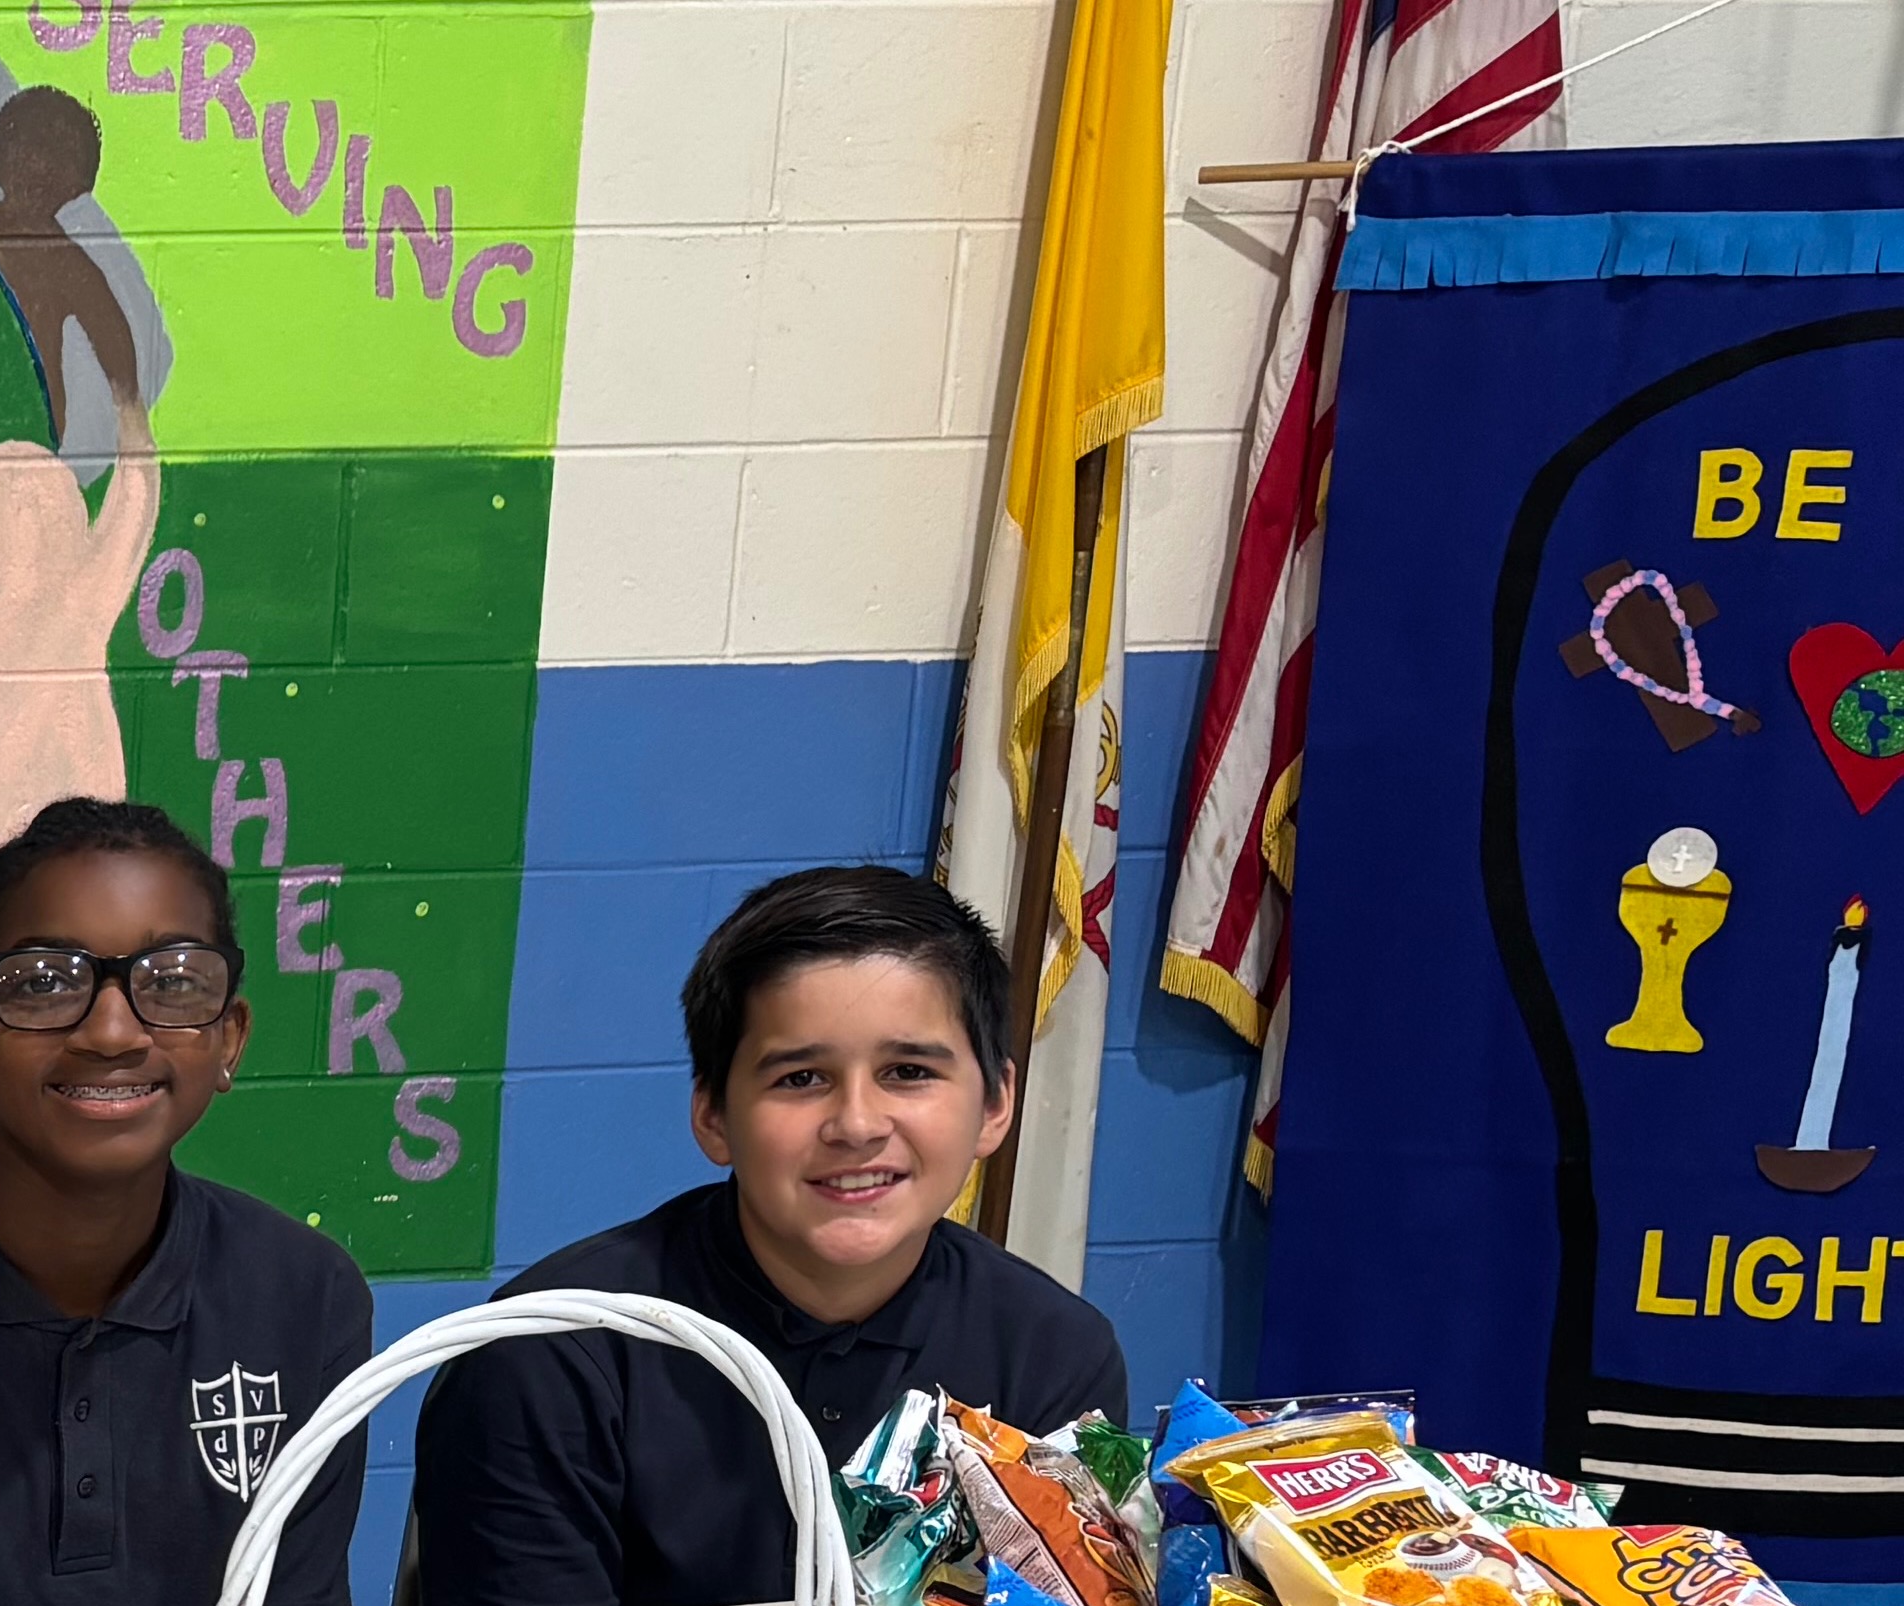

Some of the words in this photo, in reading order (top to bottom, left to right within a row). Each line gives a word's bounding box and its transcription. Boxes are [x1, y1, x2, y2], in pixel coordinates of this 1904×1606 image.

[1693, 448, 1853, 543] BE
[137, 547, 461, 1182] OTHERS
[212, 1393, 226, 1416] S
[249, 1389, 264, 1411] V
[1270, 1454, 1378, 1499] HERR'S
